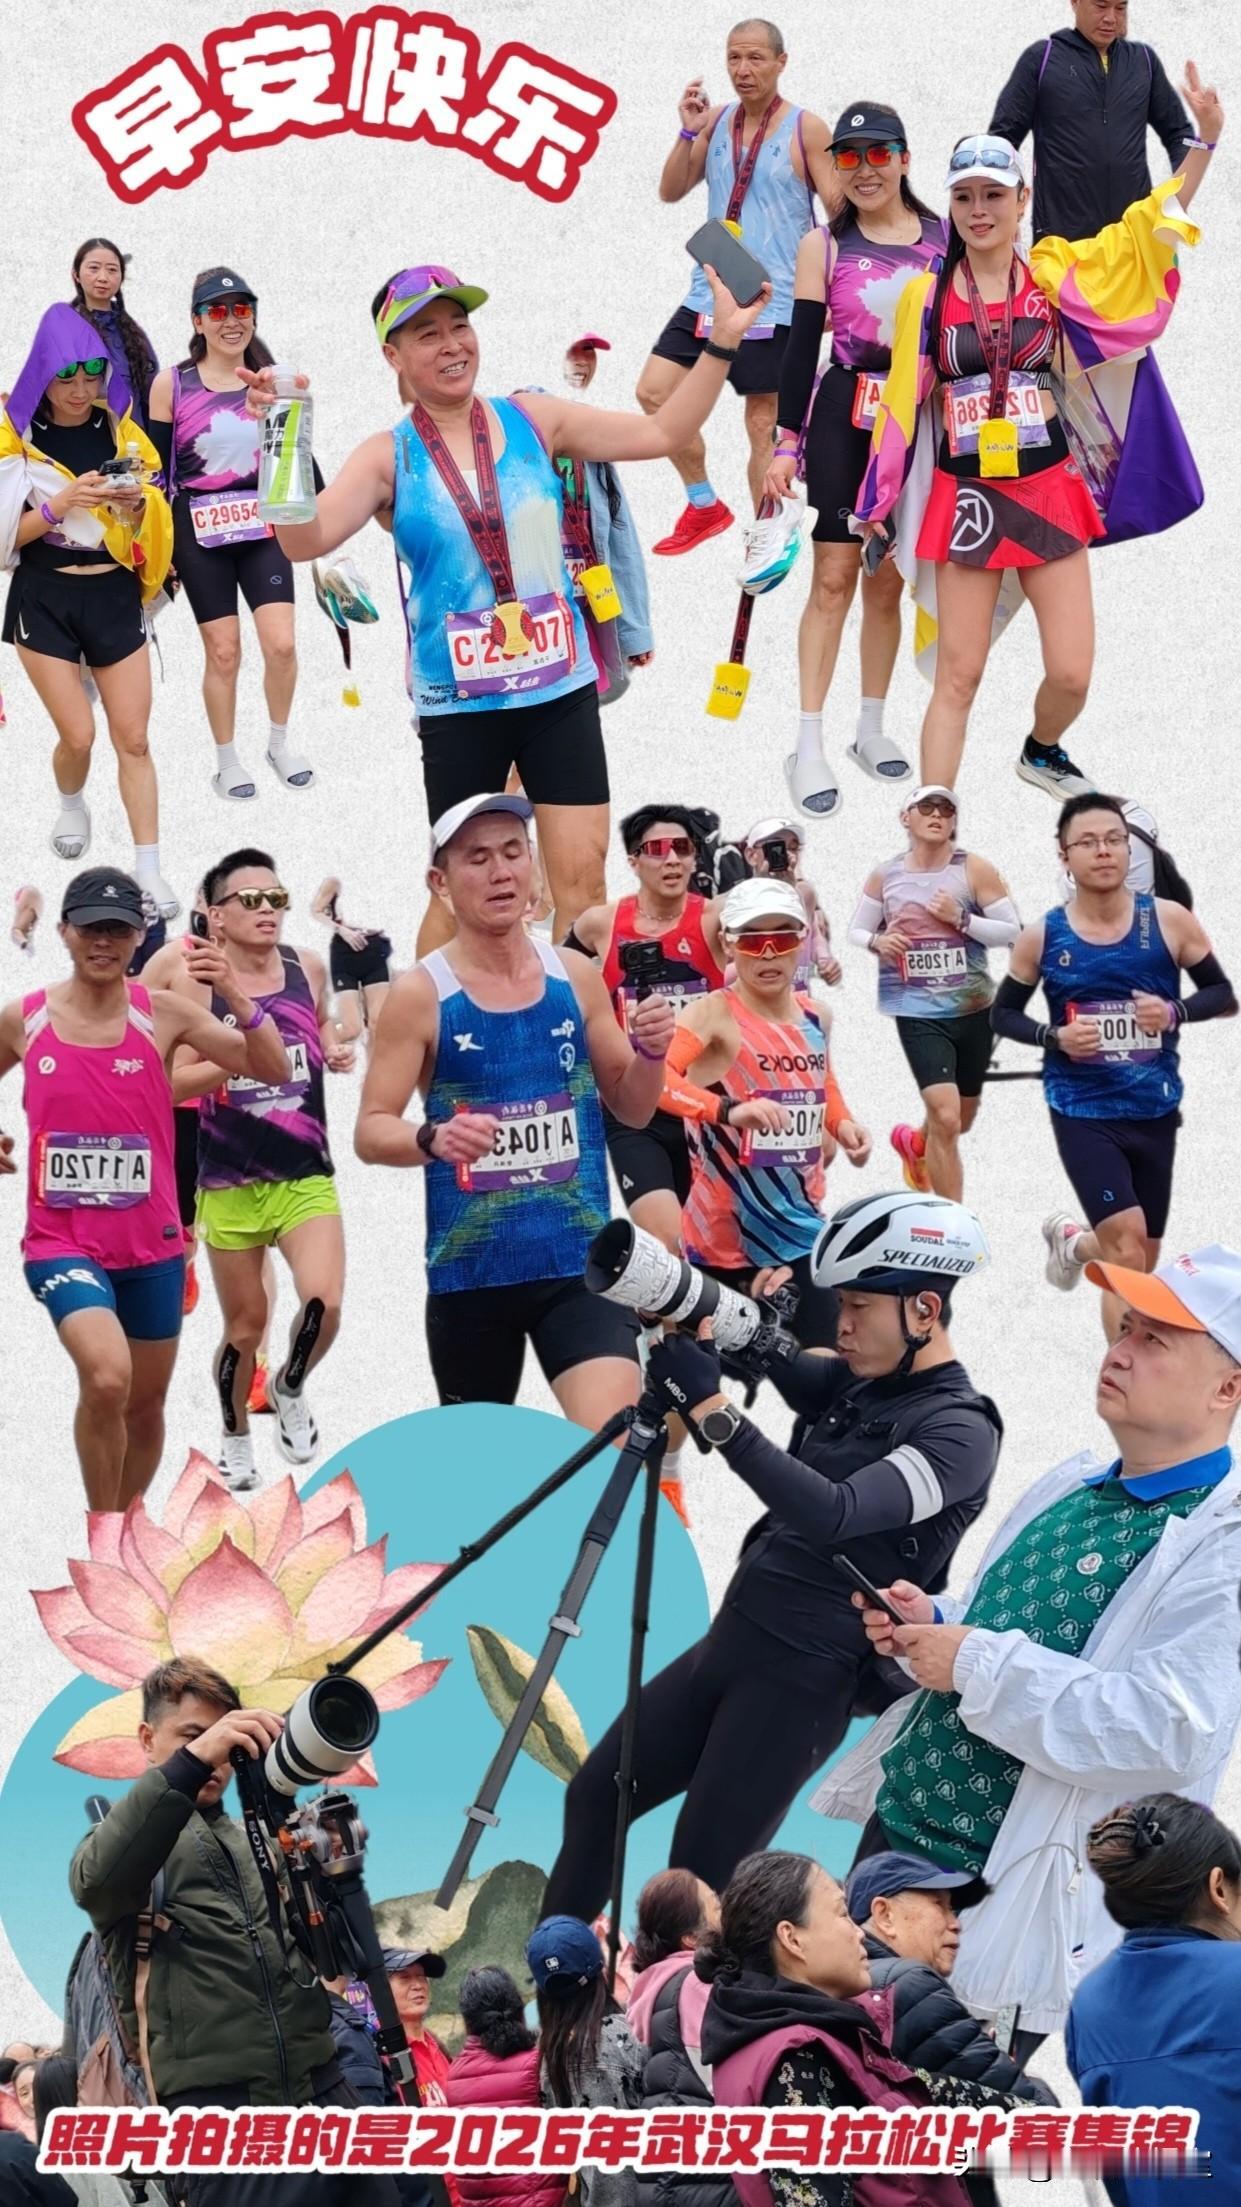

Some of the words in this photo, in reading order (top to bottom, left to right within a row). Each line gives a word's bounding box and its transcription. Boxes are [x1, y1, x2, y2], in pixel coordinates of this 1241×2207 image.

[481, 616, 561, 665] 207
[911, 1235, 944, 1246] SOUDAL
[877, 1249, 975, 1273] SPECIALIZED
[664, 1377, 687, 1403] MBO
[248, 1821, 271, 1871] SONY
